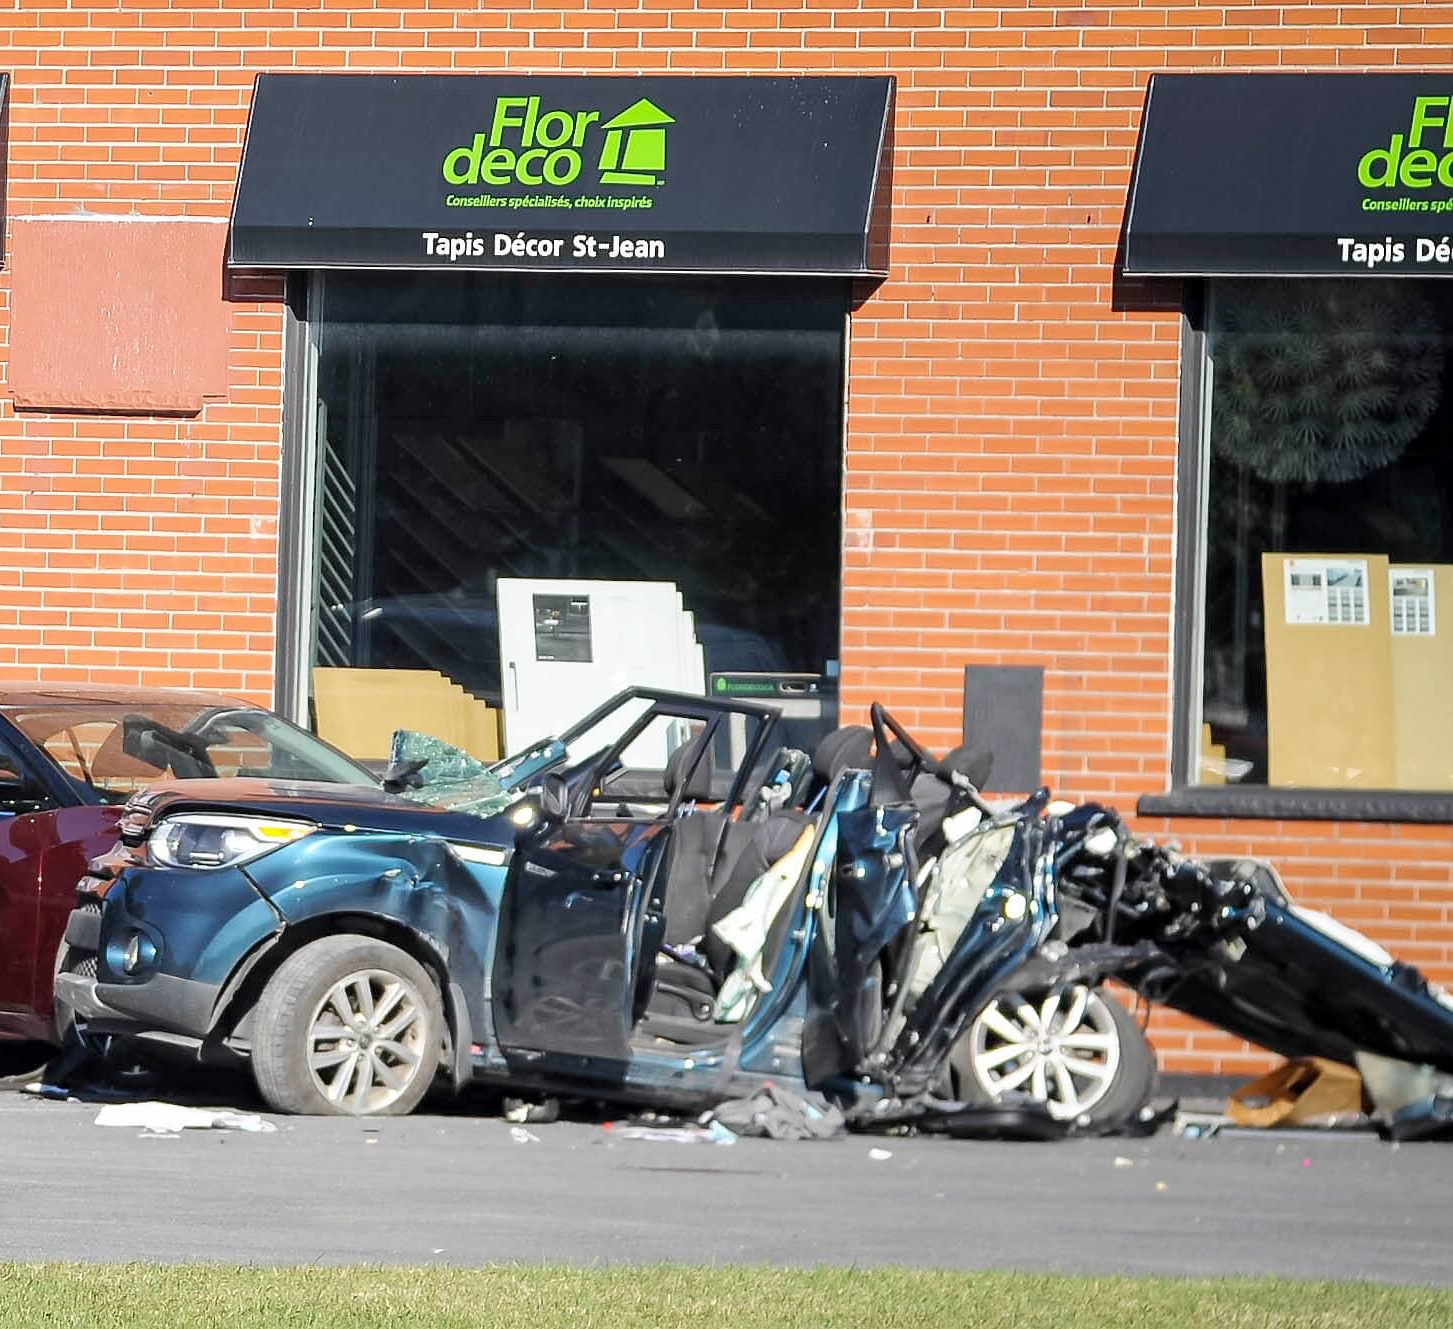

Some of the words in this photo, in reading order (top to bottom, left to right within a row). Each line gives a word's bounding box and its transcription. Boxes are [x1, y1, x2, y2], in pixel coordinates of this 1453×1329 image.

[490, 96, 600, 147] Flor
[442, 134, 582, 186] deco
[446, 195, 507, 207] Conseillers
[508, 195, 573, 210] spécialisés,
[574, 195, 605, 208] choix
[607, 196, 653, 211] inspirés
[1362, 199, 1429, 211] Conseillers
[422, 232, 484, 261] Tapis
[494, 232, 564, 257] Décor
[573, 234, 665, 258] St-Jean
[1337, 237, 1405, 268] Tapis
[1416, 237, 1453, 263] Dé
